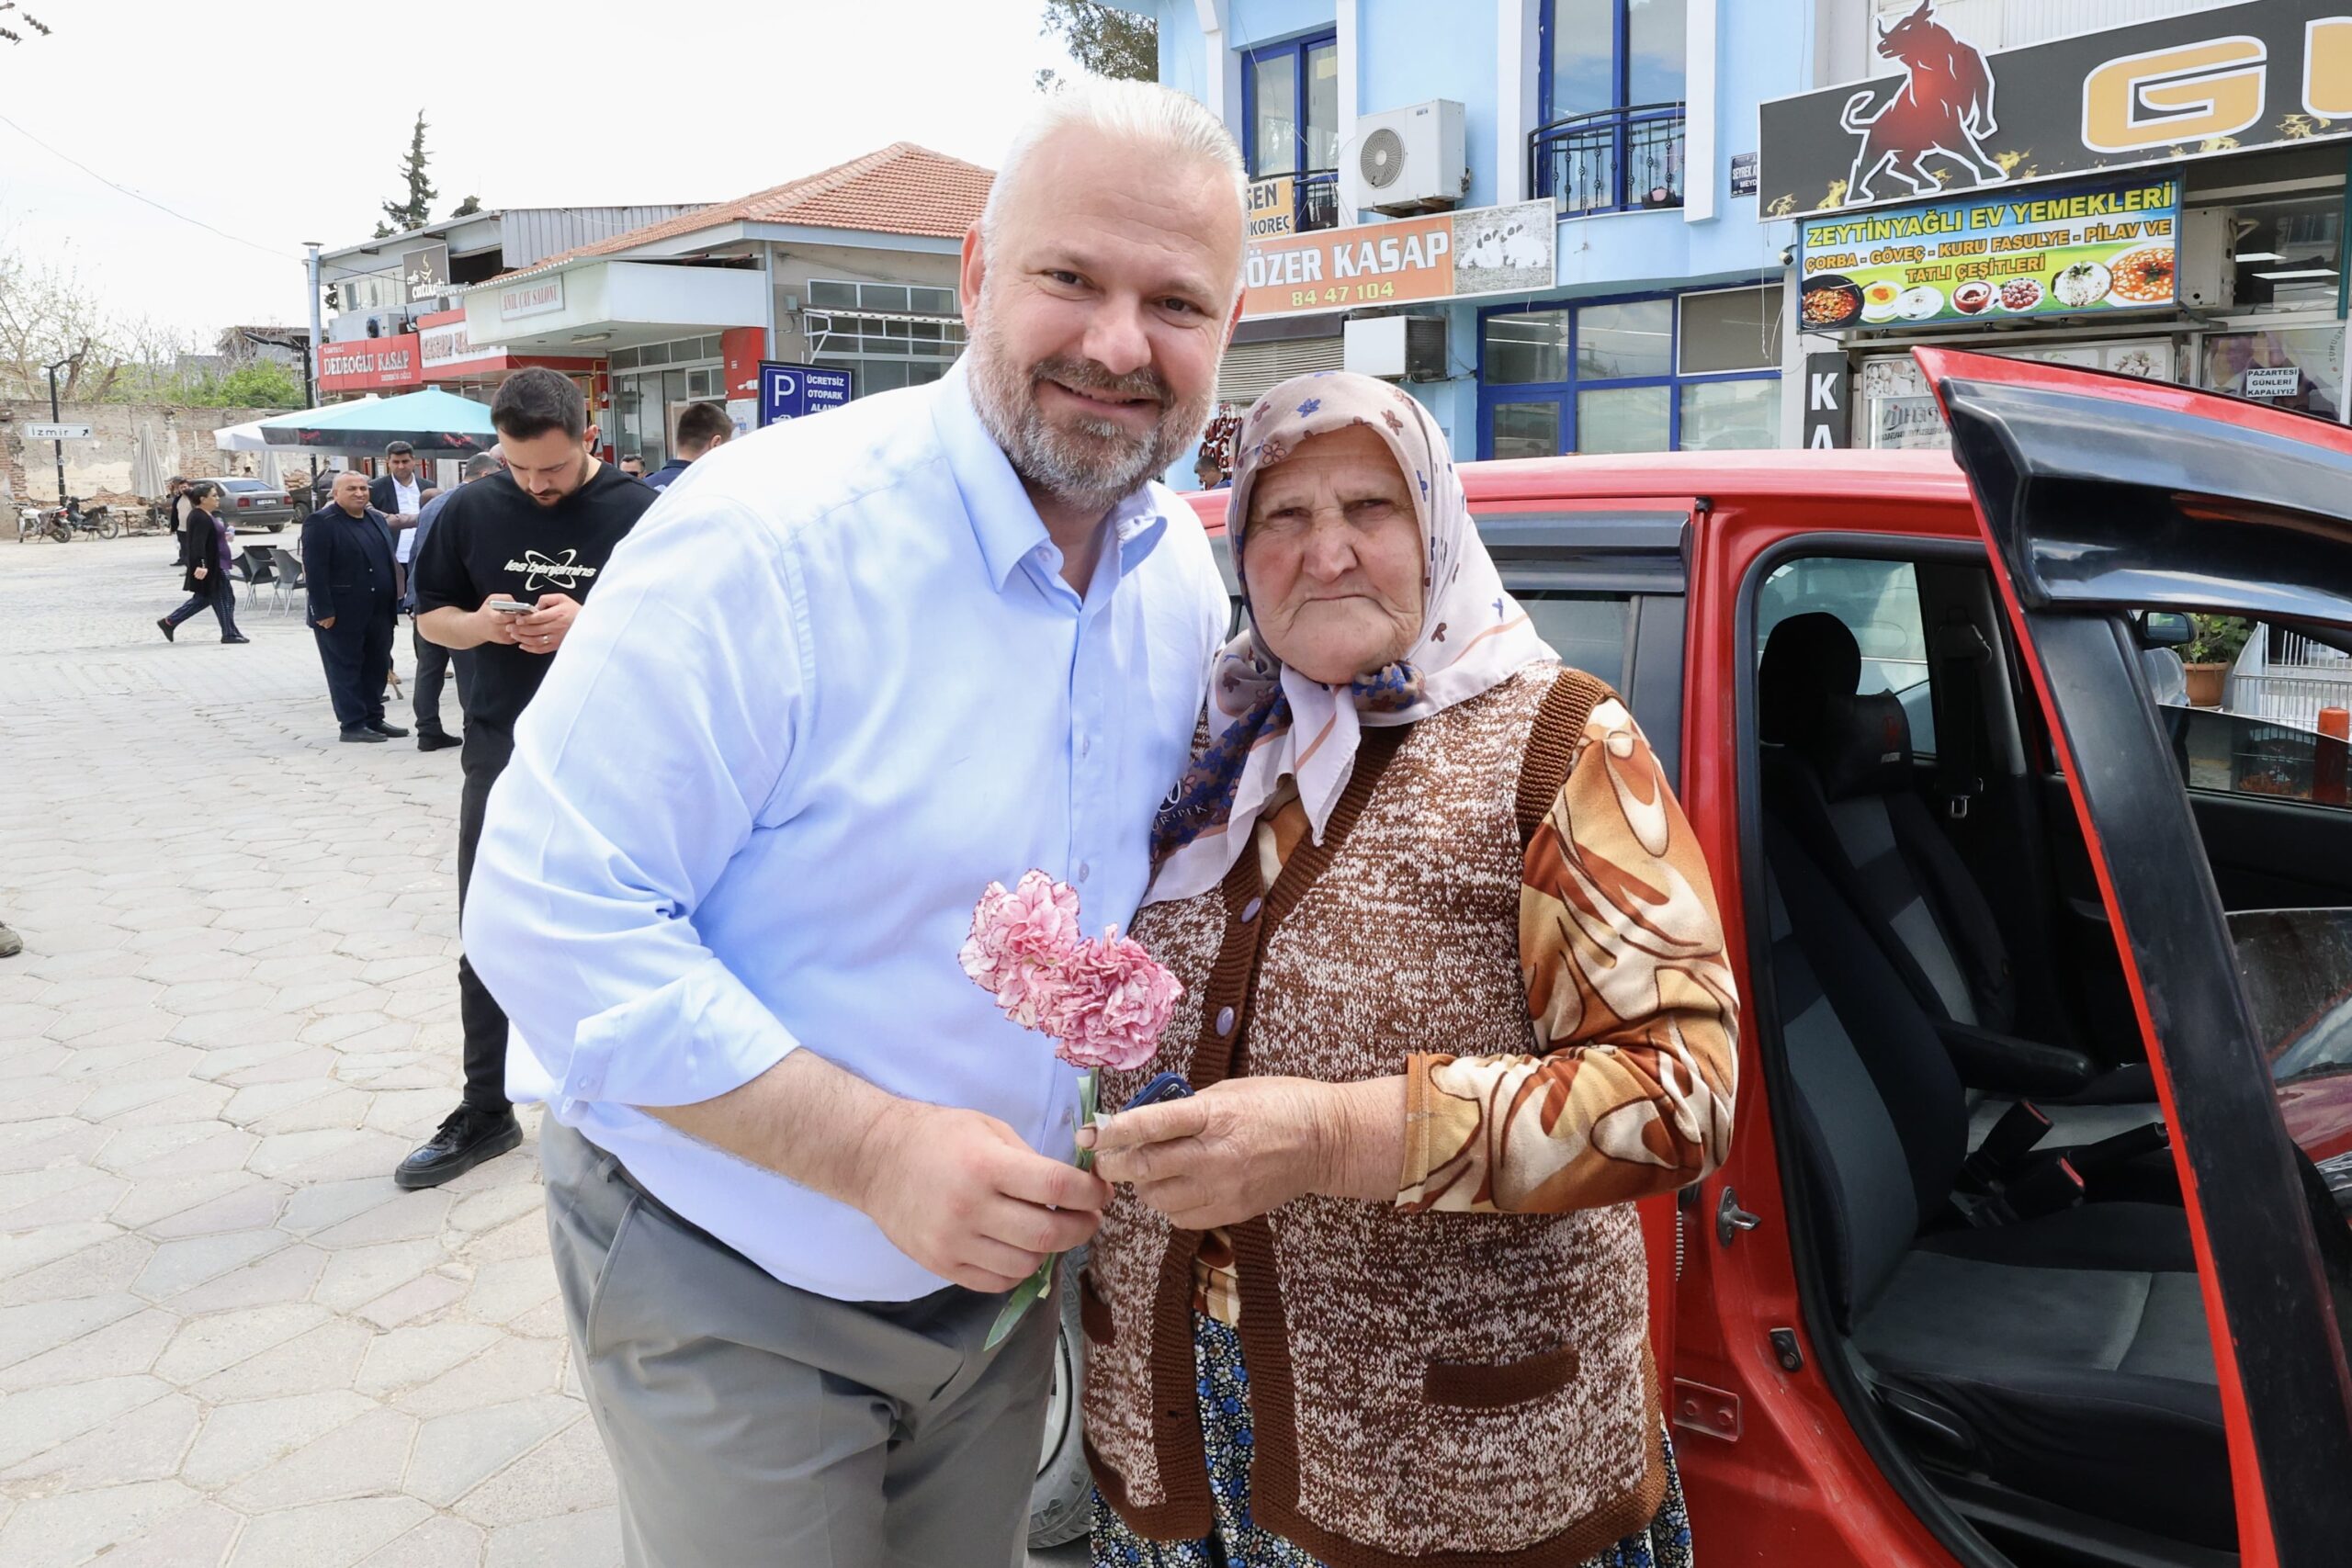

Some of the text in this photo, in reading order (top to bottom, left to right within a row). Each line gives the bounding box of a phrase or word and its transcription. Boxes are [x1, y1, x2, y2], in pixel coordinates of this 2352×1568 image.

[1806, 181, 2173, 247] ZEYTİNYAĞLI EV YEMEKLERİ
[1247, 231, 1449, 288] ÖZER KASAP
[1804, 254, 1857, 274] ÇORBA
[1870, 245, 1926, 265] GÖVEÇ
[1939, 239, 1987, 257] KURU
[1992, 230, 2070, 252] FASULYE
[2085, 221, 2141, 242] PİLAV
[2145, 220, 2172, 235] VE
[1906, 253, 2045, 283] TATLI ÇEŞİTLERİ
[503, 293, 517, 310] ANIL
[533, 285, 558, 305] SALONU
[1292, 281, 1395, 307] 84 47 104
[323, 350, 409, 375] DEDEOĞLU KASAP
[775, 375, 796, 406] P
[807, 374, 844, 387] ÜCRETSİZ
[808, 389, 843, 400] OTOPARK
[504, 559, 596, 577] les benjamins
